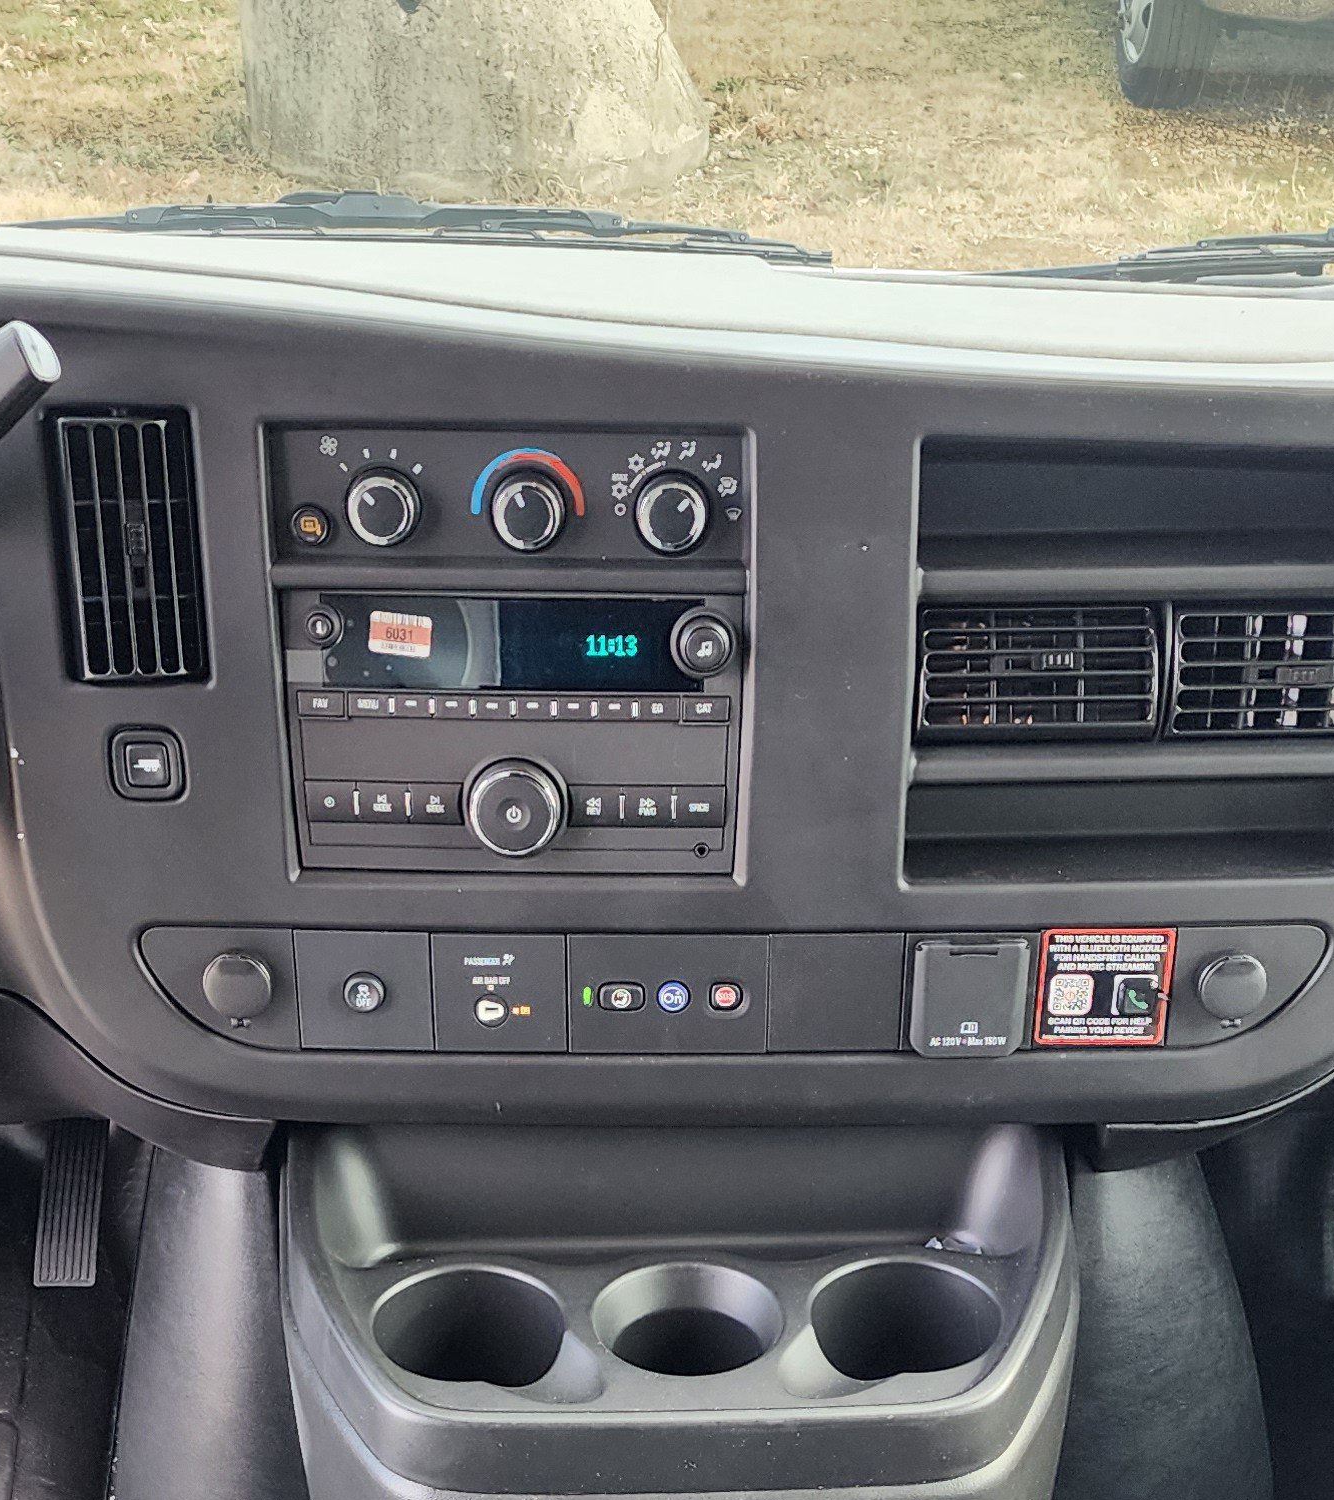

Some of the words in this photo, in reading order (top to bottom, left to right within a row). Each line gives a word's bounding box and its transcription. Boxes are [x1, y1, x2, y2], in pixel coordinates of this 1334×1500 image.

[385, 627, 414, 641] 6U31
[586, 634, 638, 657] 11:13
[312, 698, 329, 709] FAV
[357, 698, 379, 710] MENU
[695, 702, 713, 715] CAT
[586, 806, 601, 816] REV
[1054, 935, 1074, 943] THIS
[1075, 935, 1110, 943] VEHICLE
[1112, 935, 1120, 943] IS
[1121, 935, 1165, 943] EQUIPPED
[1072, 944, 1079, 953] A
[1080, 944, 1130, 953] BLUETOOTH
[1130, 944, 1167, 953] MODULE
[1053, 954, 1072, 962] FOR
[1073, 954, 1123, 962] HANDSFREE
[1124, 954, 1160, 962] CALLING
[1057, 963, 1076, 971] AND
[1077, 963, 1105, 971] MUSIC
[1106, 963, 1155, 971] STREAMING
[355, 998, 371, 1007] OFF
[929, 1037, 941, 1046] AC
[967, 1036, 983, 1046] Max
